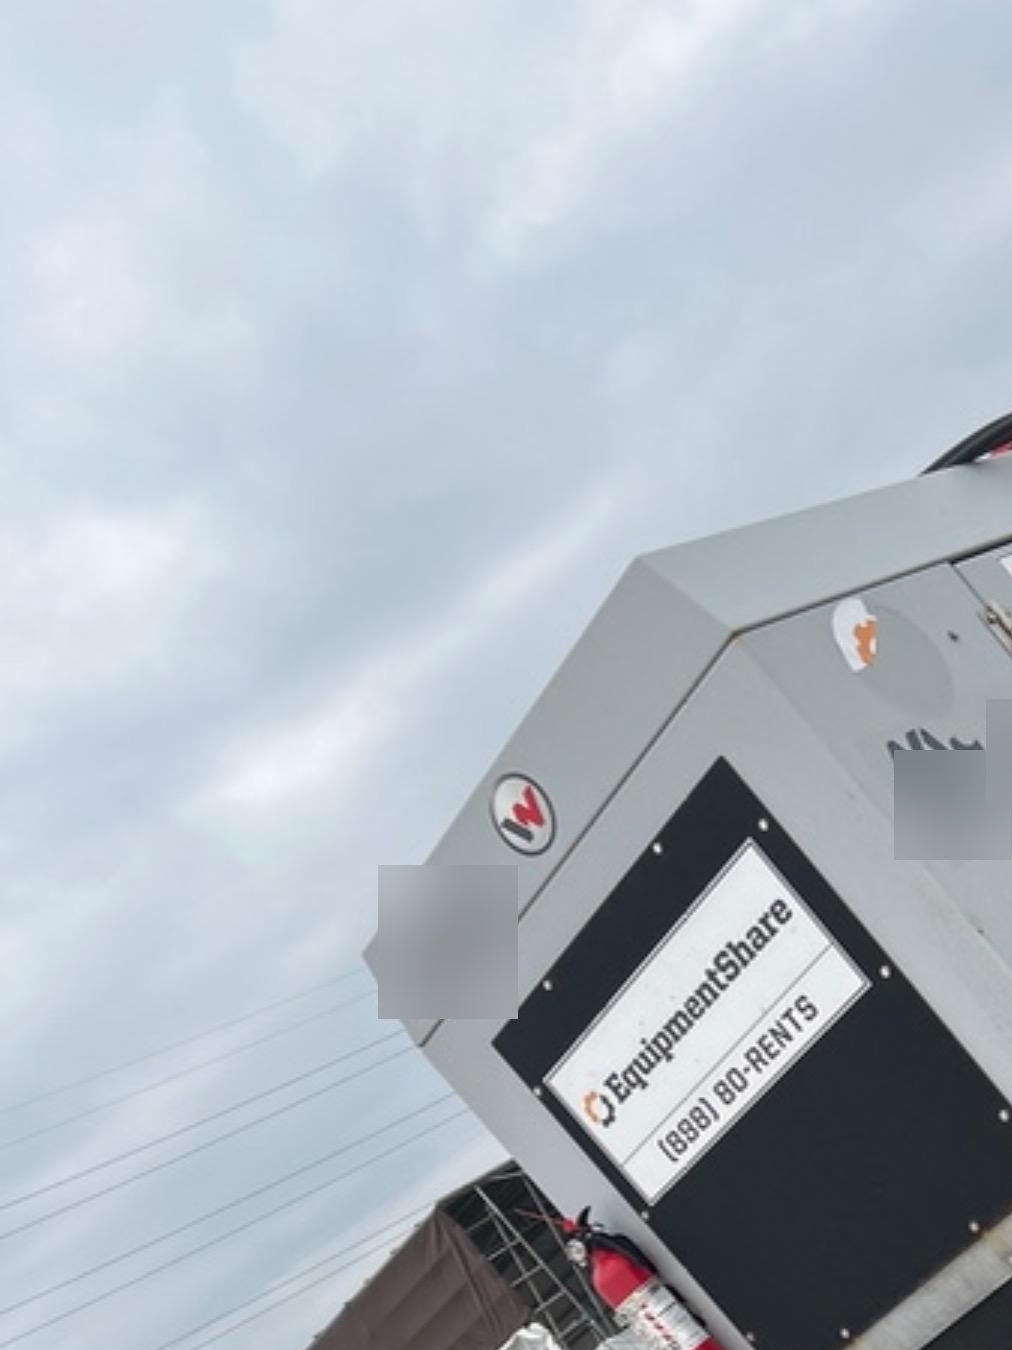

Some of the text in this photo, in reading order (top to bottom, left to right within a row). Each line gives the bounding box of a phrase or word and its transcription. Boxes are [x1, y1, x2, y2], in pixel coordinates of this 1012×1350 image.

[604, 898, 794, 1104] EquipmentShare
[657, 994, 820, 1163] (888) 80-RENTS
